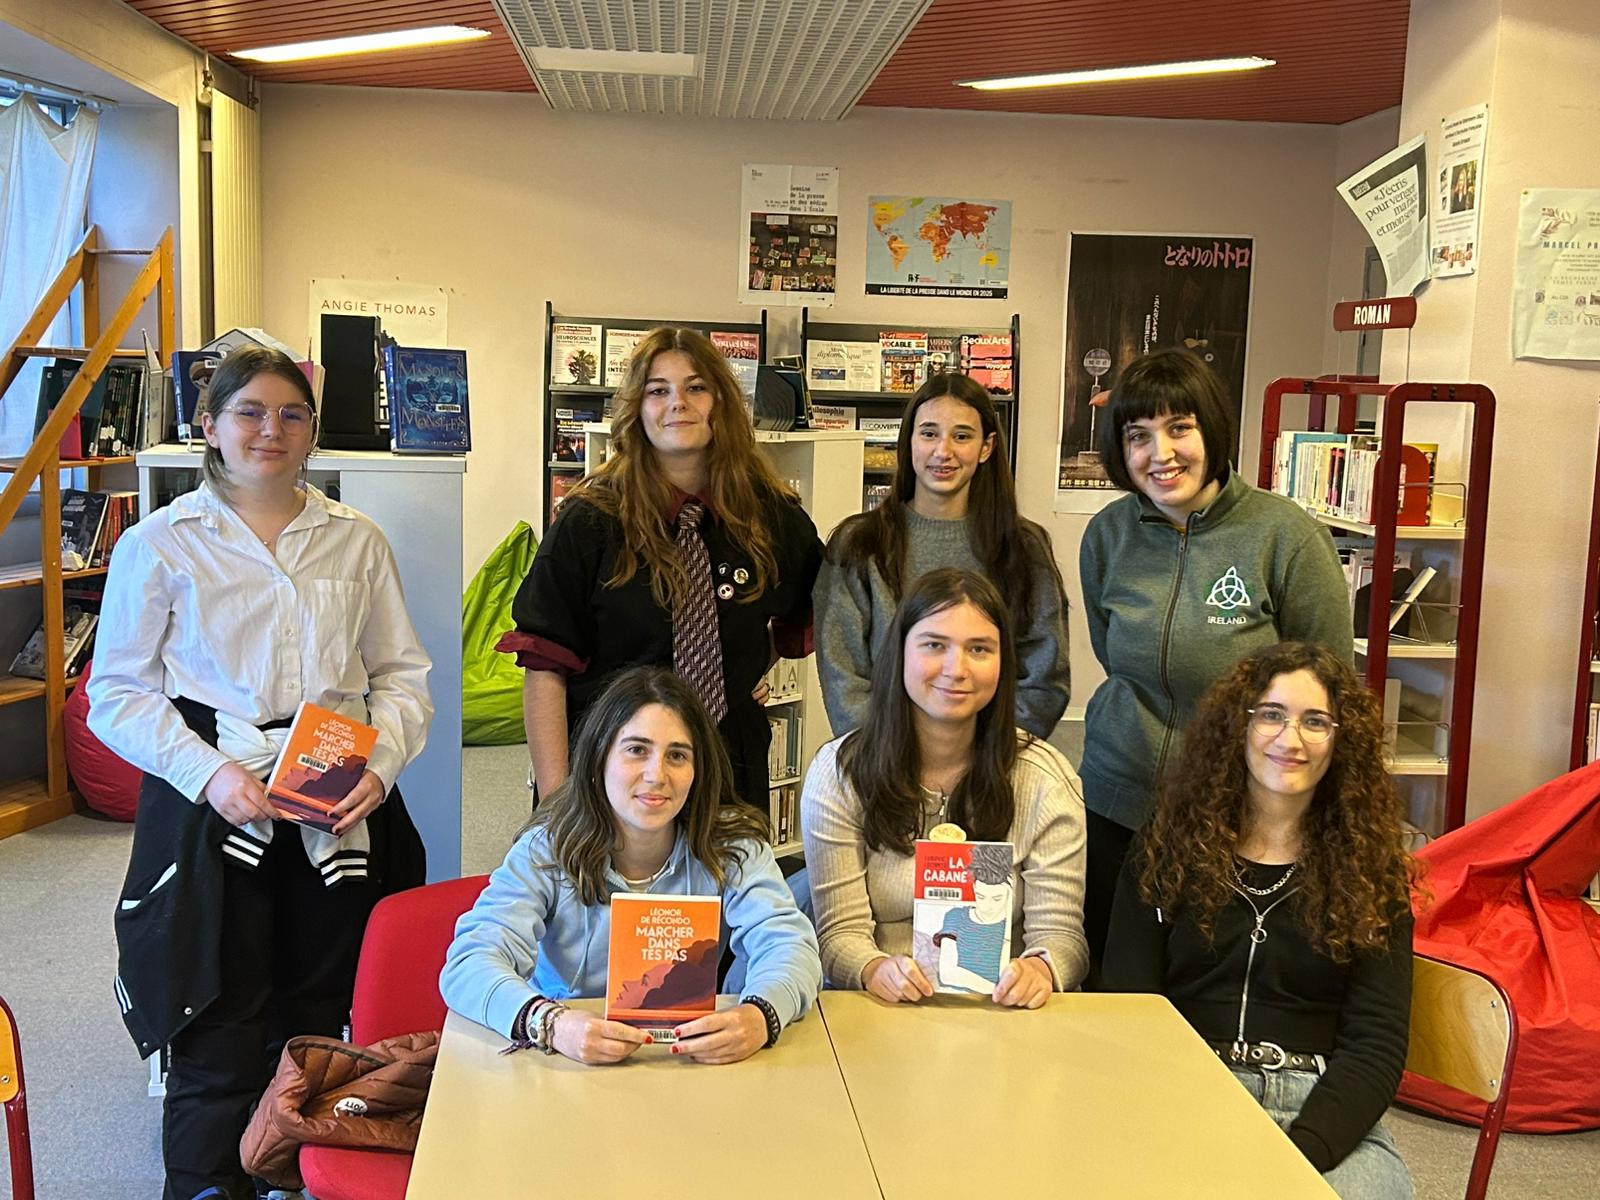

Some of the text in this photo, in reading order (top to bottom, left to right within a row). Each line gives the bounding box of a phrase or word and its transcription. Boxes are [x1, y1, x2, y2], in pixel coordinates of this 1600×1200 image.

[1365, 201, 1391, 221] pour
[1376, 226, 1385, 237] et
[1385, 213, 1404, 233] mon
[1543, 241, 1581, 249] MARCEL
[1164, 241, 1250, 268] となりのトトロ
[321, 300, 436, 316] ANGIE THOMAS
[1354, 304, 1391, 325] ROMAN
[1207, 616, 1247, 625] IRELAND
[328, 718, 352, 732] LÉONOR
[328, 725, 356, 740] RÉCONDO
[313, 729, 355, 752] MARCHER
[319, 741, 344, 757] DANS
[312, 747, 345, 767] TES PAS
[949, 856, 965, 869] LA
[923, 868, 968, 883] CABANE
[650, 907, 682, 917] LÉONOR
[640, 915, 691, 925] DE RÉCONDO
[635, 926, 694, 938] MARCHER
[648, 938, 681, 949] DANS
[641, 949, 688, 962] TES PAS
